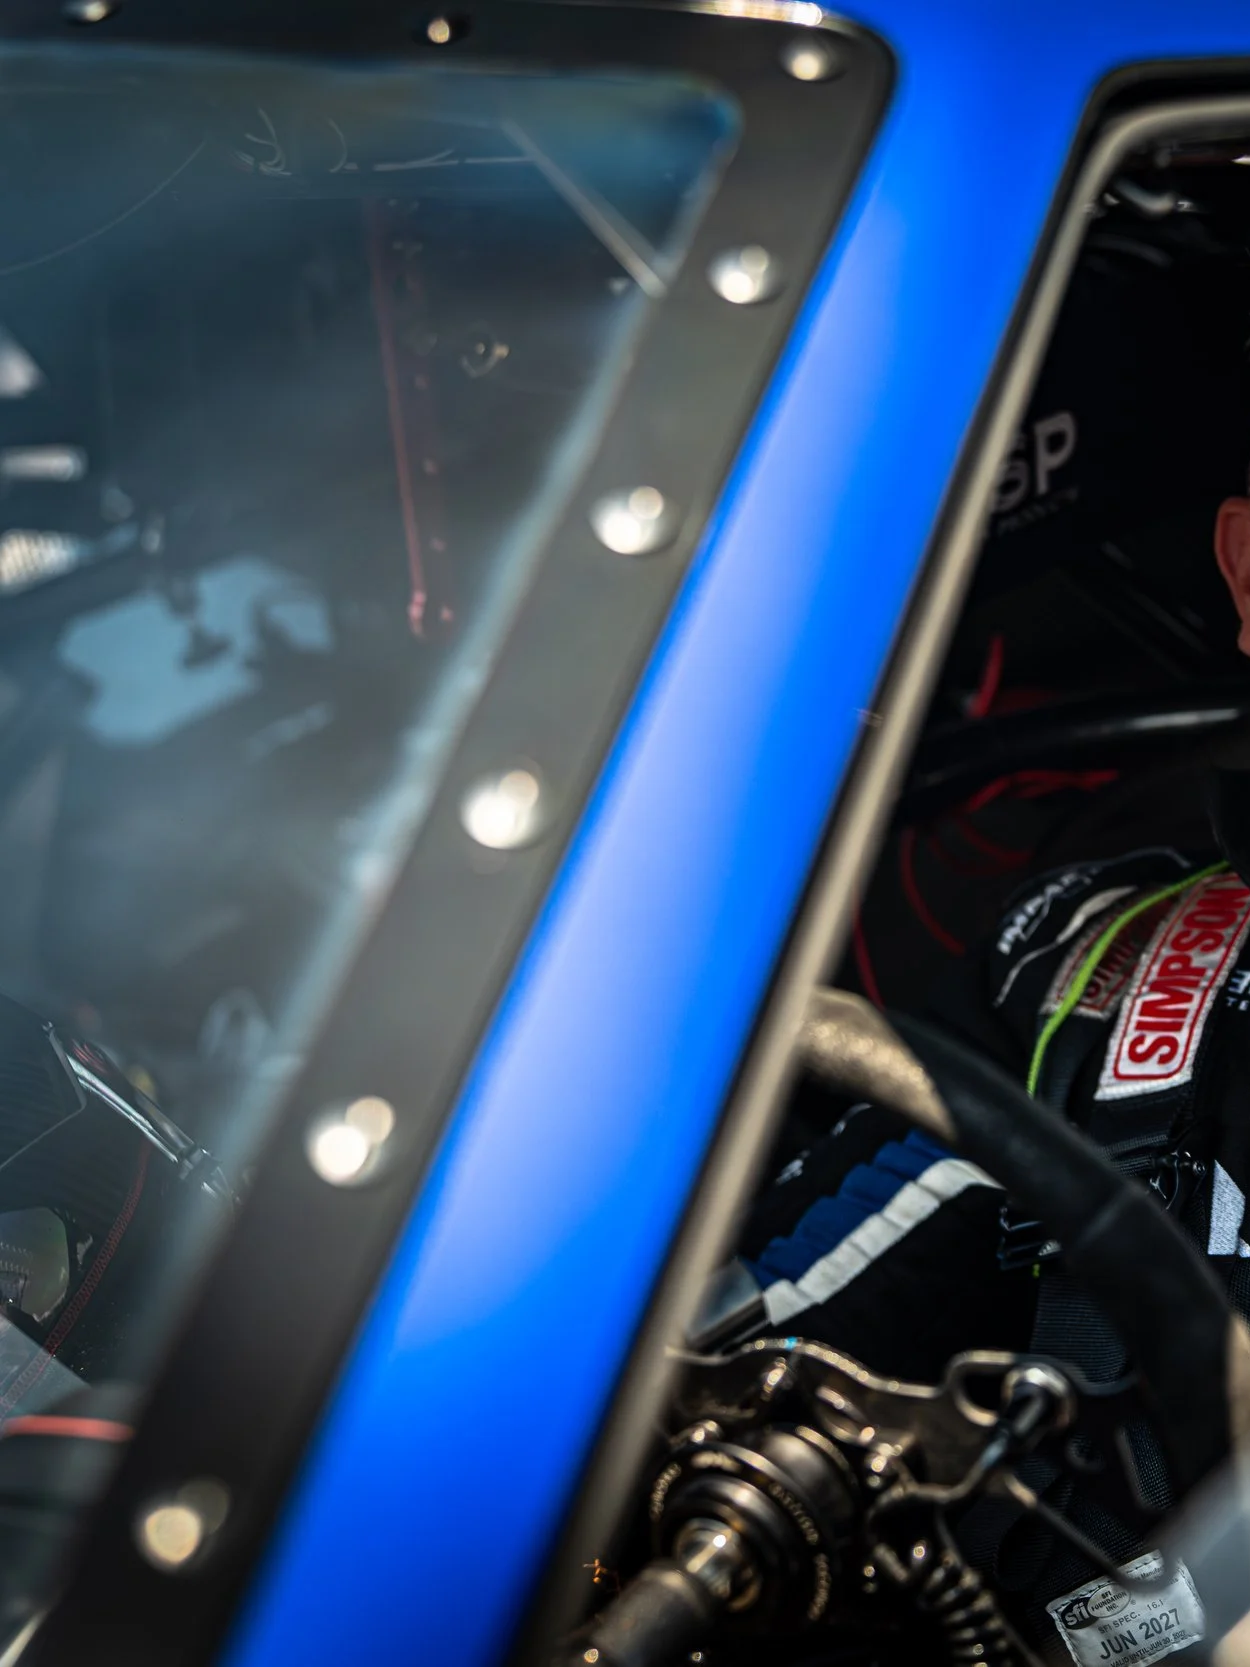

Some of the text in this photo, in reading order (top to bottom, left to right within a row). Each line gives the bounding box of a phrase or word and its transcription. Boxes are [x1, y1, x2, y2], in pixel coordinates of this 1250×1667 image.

[1127, 886, 1250, 1065] SIMPSON
[1091, 1590, 1128, 1612] FOUNDATION
[1065, 1602, 1091, 1627] sfi
[1113, 1611, 1142, 1630] SPEC.
[1099, 1607, 1182, 1660] JUN 2027
